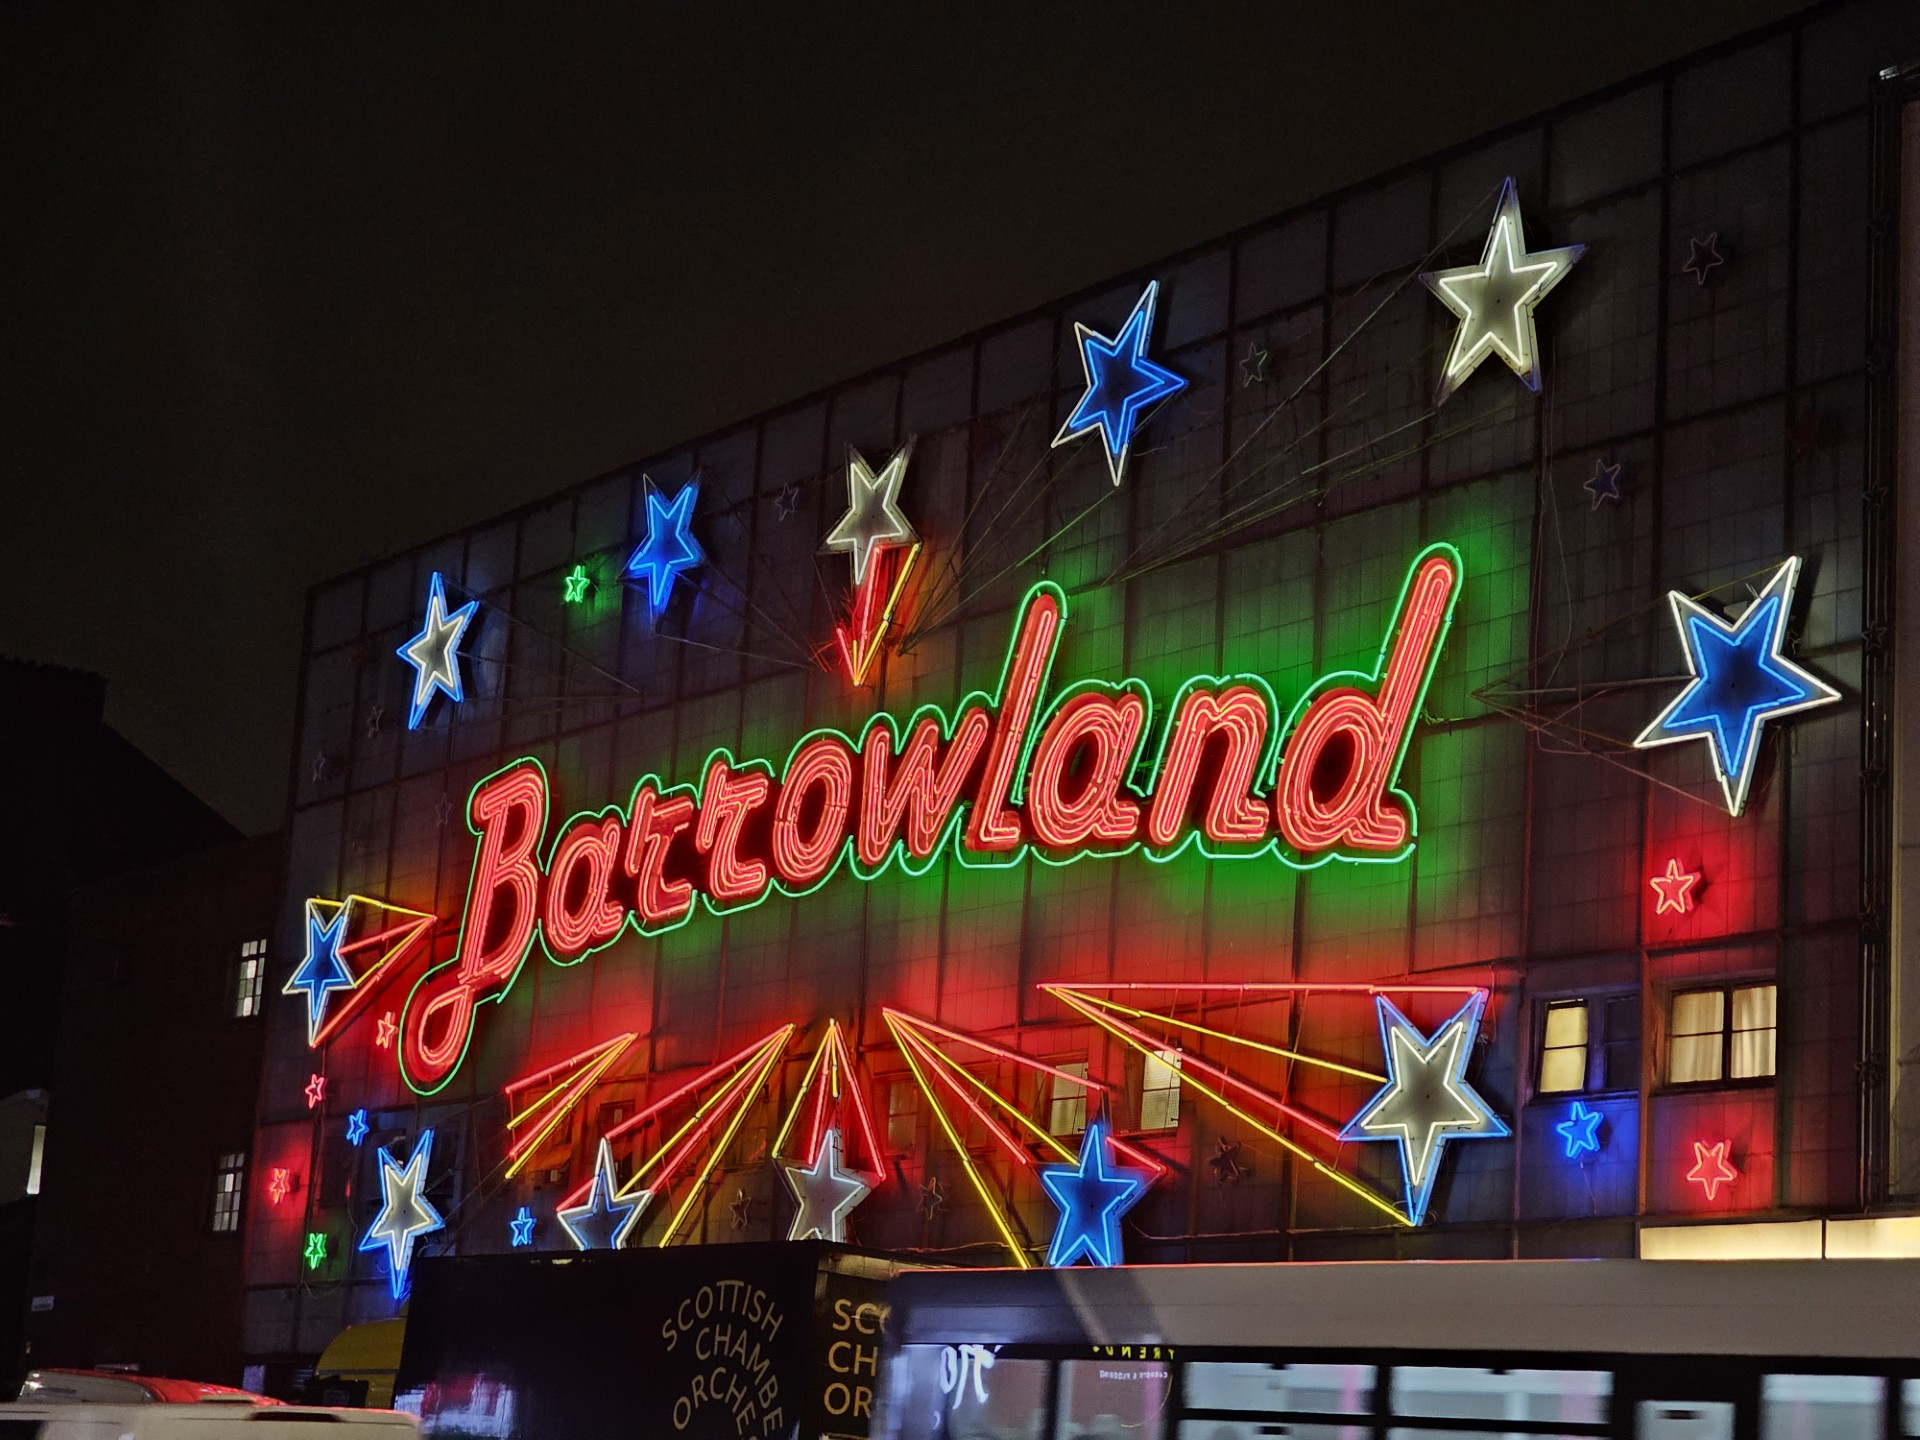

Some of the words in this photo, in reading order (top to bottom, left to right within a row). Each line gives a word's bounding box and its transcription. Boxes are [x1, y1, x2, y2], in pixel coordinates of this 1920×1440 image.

[402, 544, 1463, 1092] Barrowland
[662, 1279, 784, 1352] SCOTTISH
[673, 1366, 757, 1440] ORCHE
